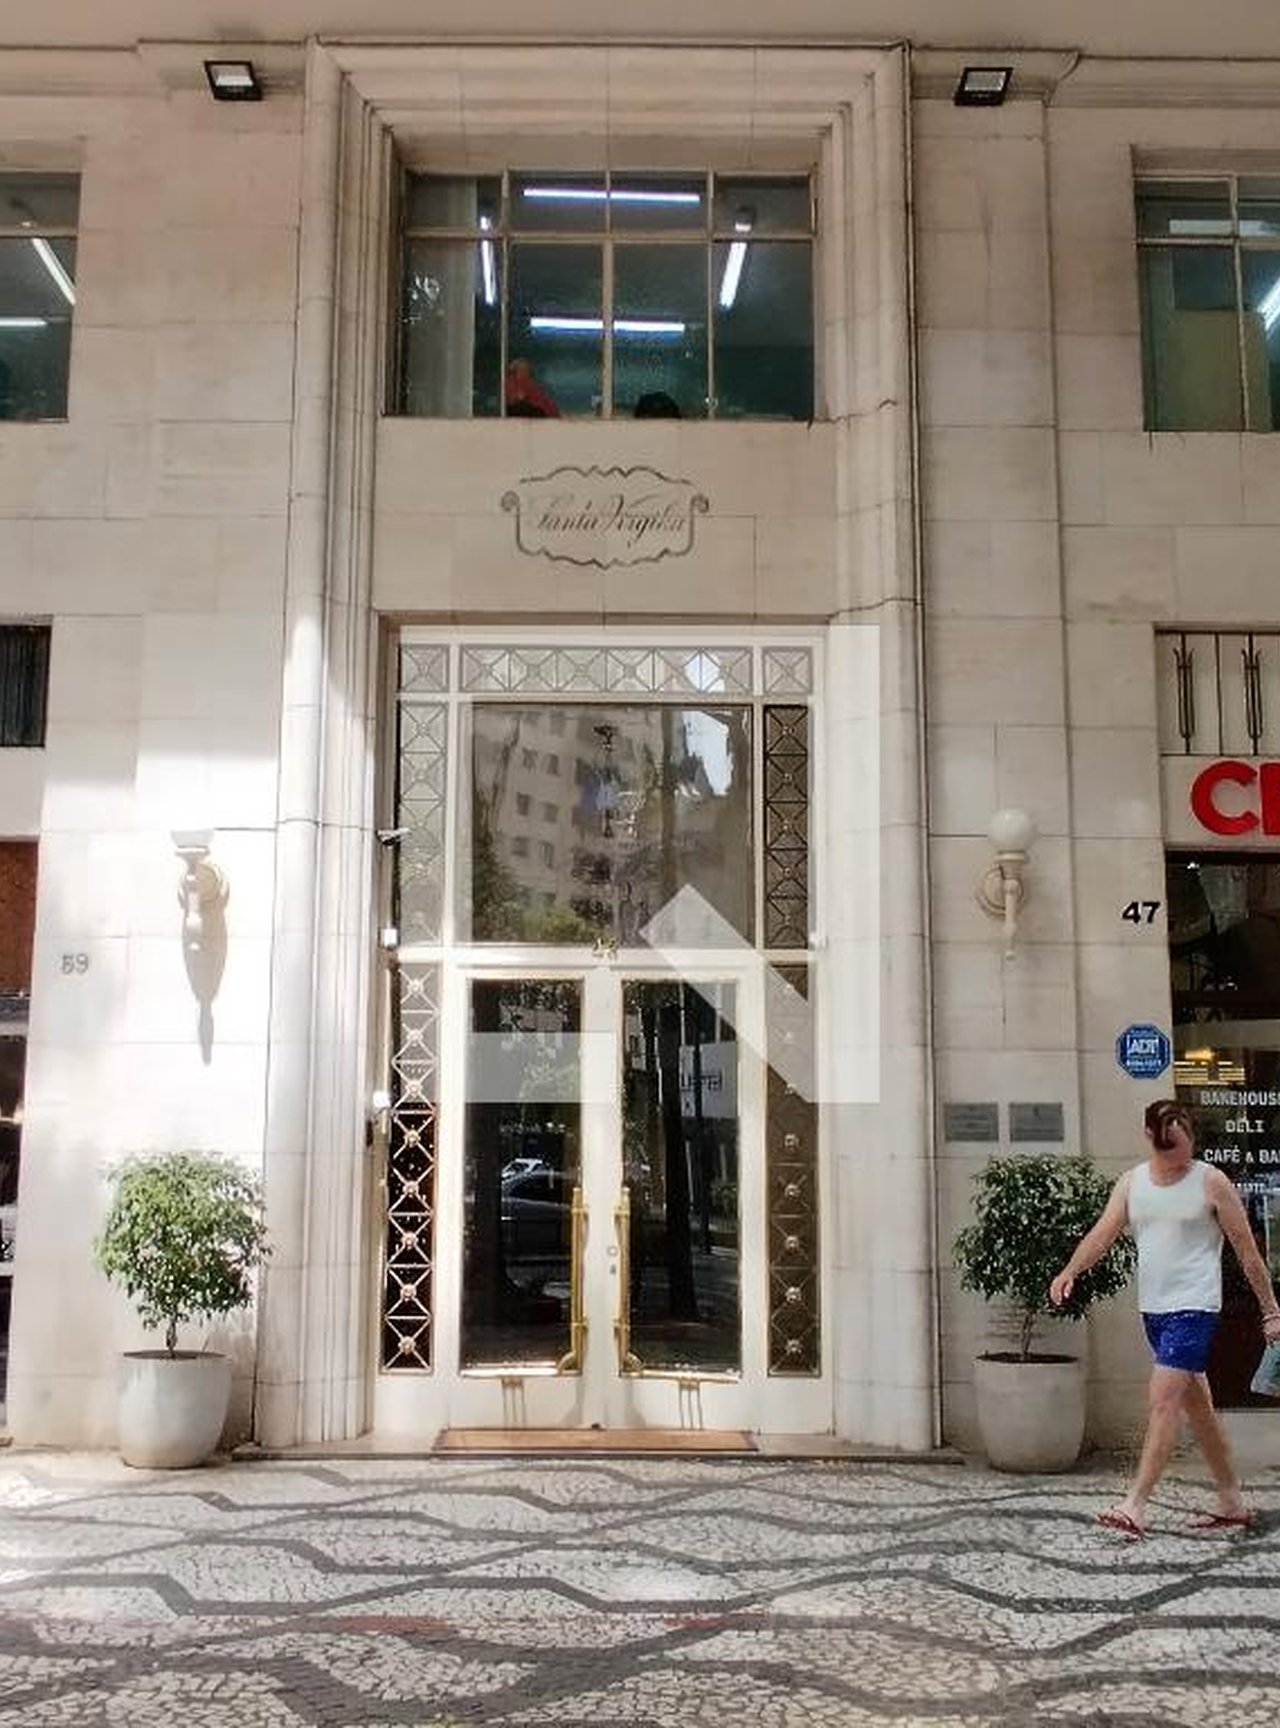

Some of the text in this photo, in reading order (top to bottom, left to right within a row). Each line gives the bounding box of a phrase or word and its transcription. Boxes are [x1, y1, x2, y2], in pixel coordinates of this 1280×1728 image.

[1122, 901, 1161, 923] 47
[1225, 1119, 1265, 1133] DELI
[1203, 1145, 1241, 1163] CAFÉ
